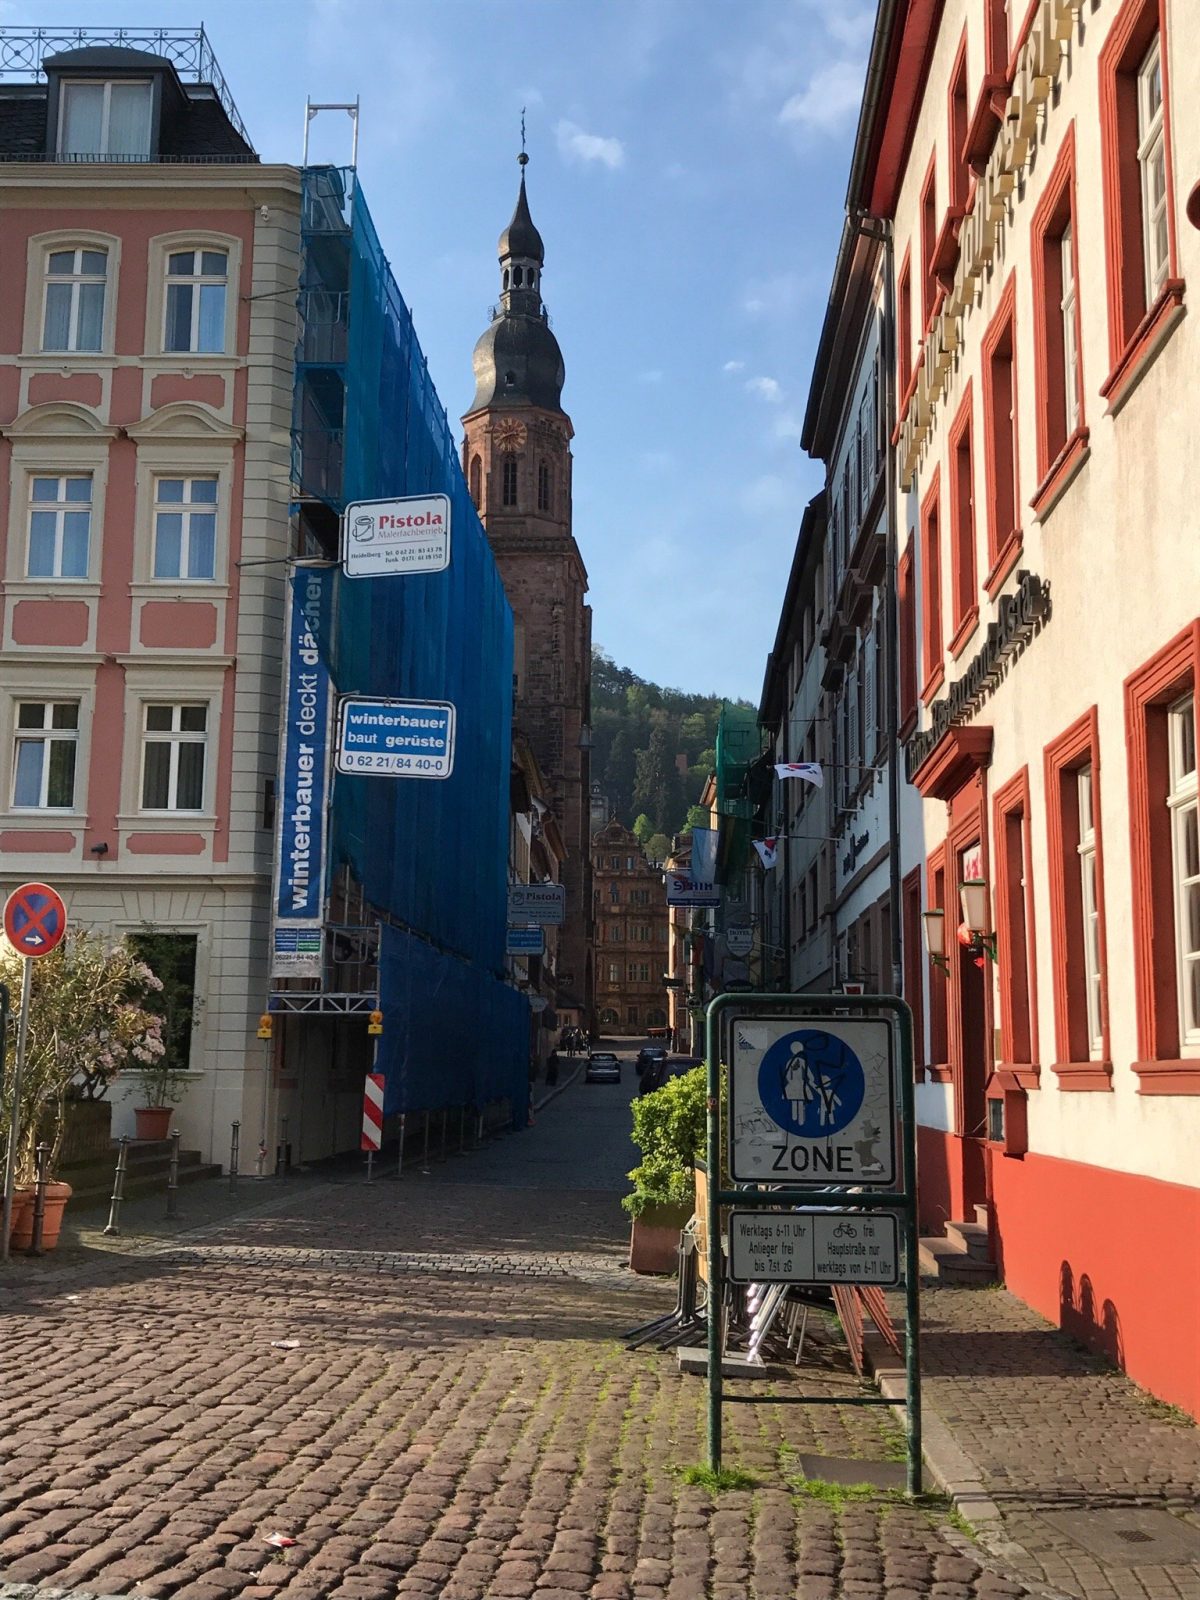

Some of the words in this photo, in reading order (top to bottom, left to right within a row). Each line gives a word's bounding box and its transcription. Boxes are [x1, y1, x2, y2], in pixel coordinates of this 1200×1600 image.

[379, 512, 442, 529] Pistola
[298, 574, 322, 666] dächer
[296, 673, 318, 736] deckt
[350, 713, 446, 729] winterbauer
[348, 732, 378, 744] baut
[386, 735, 445, 748] gerüste
[346, 755, 354, 765] 0
[357, 756, 372, 766] 62
[376, 756, 411, 769] 21/84
[416, 759, 443, 770] 40-0
[288, 743, 315, 910] winterbauer
[526, 892, 561, 900] Pistola
[772, 1145, 853, 1172] ZONE
[740, 1224, 772, 1239] Werktags
[776, 1224, 790, 1236] 6-11
[793, 1225, 806, 1238] Uhr
[863, 1224, 875, 1236] frei
[749, 1242, 778, 1257] Anlieger
[782, 1242, 794, 1255] frei
[827, 1242, 866, 1258] Hauptstraße
[869, 1245, 880, 1255] nur
[755, 1260, 765, 1272] bis
[784, 1260, 792, 1272] zG
[817, 1261, 846, 1277] werktags
[850, 1263, 861, 1273] von
[864, 1261, 877, 1274] 6-11
[880, 1261, 892, 1274] Uhr
